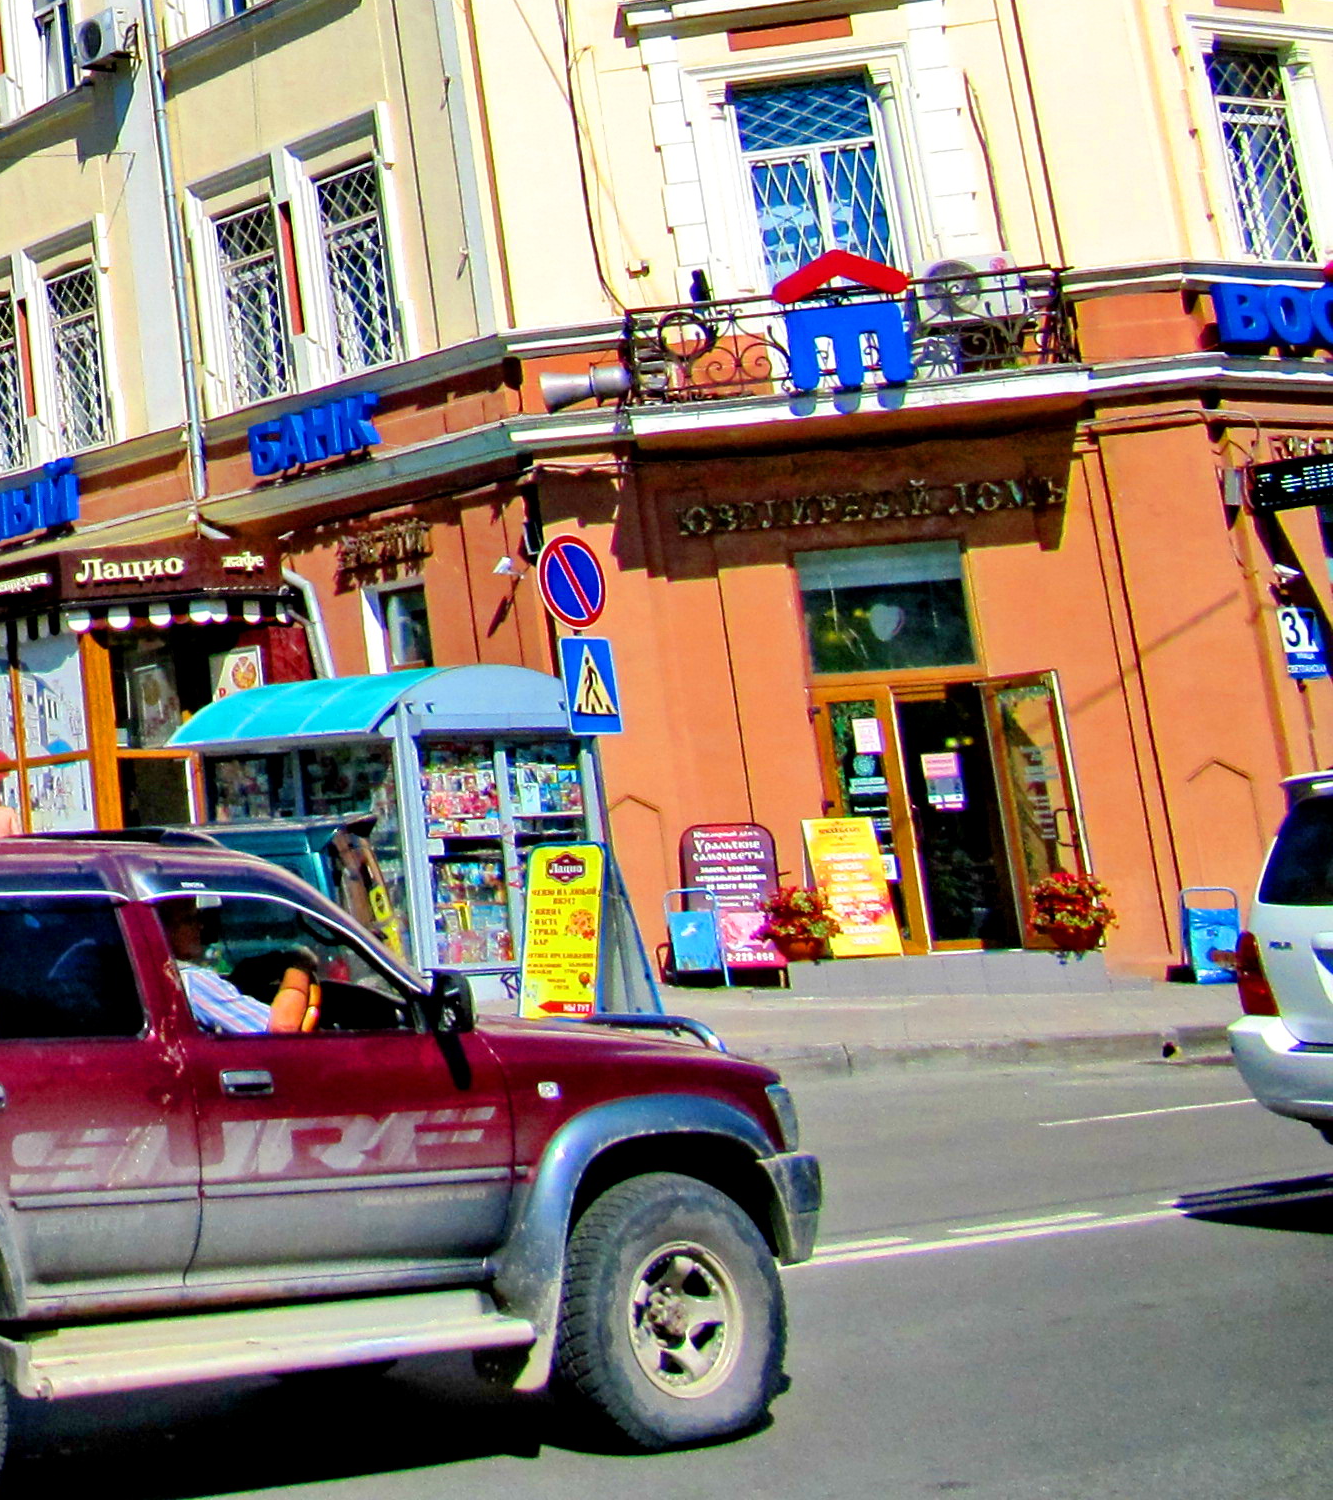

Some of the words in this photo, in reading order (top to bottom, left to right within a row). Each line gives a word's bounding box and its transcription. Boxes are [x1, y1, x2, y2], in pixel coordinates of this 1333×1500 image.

[247, 391, 382, 476] БАНК
[75, 556, 185, 584] Лацио
[220, 551, 265, 572] кафе
[1281, 611, 1314, 647] 37
[692, 851, 765, 862] самоцветы
[693, 840, 760, 853] Уральские
[548, 863, 583, 874] Лацио
[10, 1106, 496, 1191] SURF
